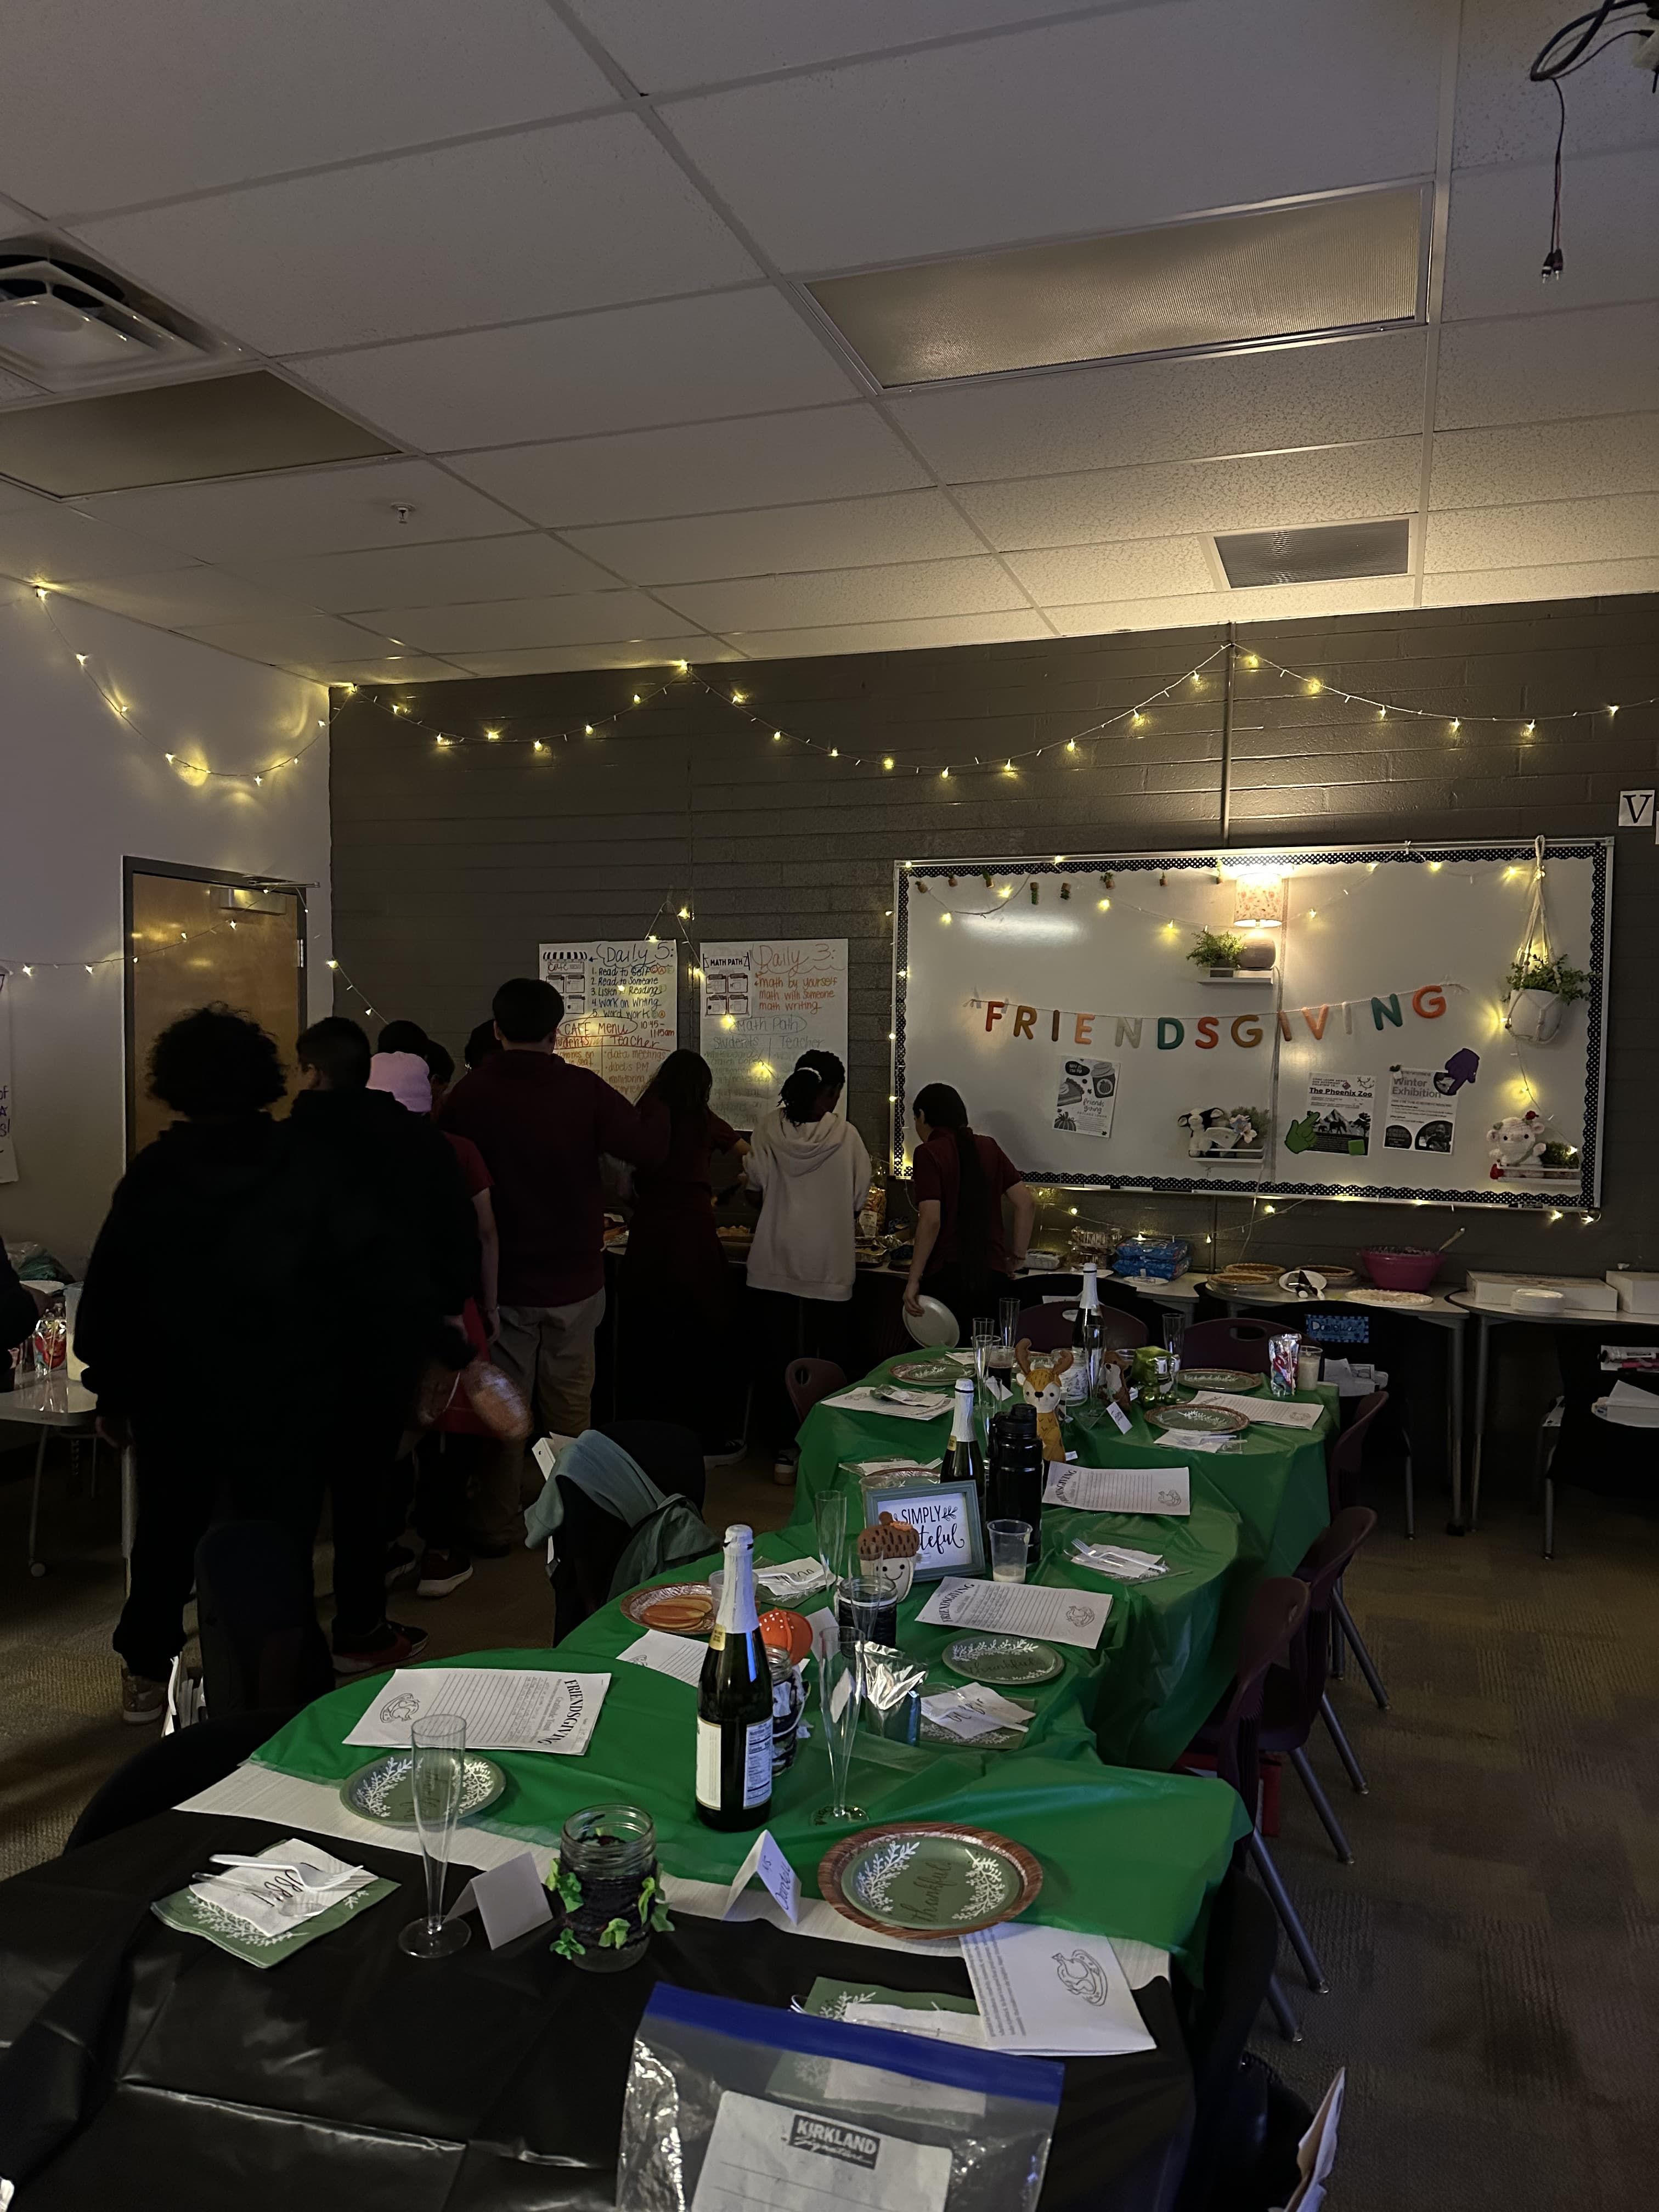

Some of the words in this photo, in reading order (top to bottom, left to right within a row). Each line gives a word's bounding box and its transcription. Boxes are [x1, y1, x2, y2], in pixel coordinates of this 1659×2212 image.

[1622, 794, 1652, 823] V
[606, 944, 650, 968] Daily
[759, 944, 802, 974] Daily
[598, 968, 618, 976] Read
[619, 967, 628, 976] to
[597, 977, 618, 986] Read
[619, 977, 628, 986] to
[628, 977, 658, 986] Someone
[759, 978, 783, 987] math
[788, 977, 798, 990] by
[803, 977, 837, 990] yourself
[599, 988, 617, 996] Listen
[629, 986, 662, 997] Reading
[759, 990, 779, 998] math
[784, 989, 801, 999] with
[620, 999, 629, 1008] on
[759, 1001, 780, 1010] math
[785, 1001, 822, 1014] writing
[985, 985, 1446, 1049] FRIENDSGIVING
[564, 1022, 591, 1036] CAFE
[598, 1022, 628, 1035] Menu
[737, 1019, 766, 1032] Math
[772, 1018, 799, 1031] Path
[610, 1036, 660, 1048] Teacher
[713, 1036, 759, 1049] Students
[778, 1035, 825, 1049] Teacher
[608, 1049, 630, 1060] data
[636, 1062, 649, 1071] PM
[1393, 1077, 1427, 1087] Winter
[1325, 1088, 1356, 1097] Phoenix
[1392, 1086, 1441, 1098] Exhibition
[901, 1505, 941, 1525] SIMPLY
[919, 1523, 965, 1555] teful
[939, 1583, 975, 1623] FRIENDSGIVING
[537, 1679, 584, 1745] FRIENDSGIVING
[796, 2119, 878, 2155] KIRKLAND
